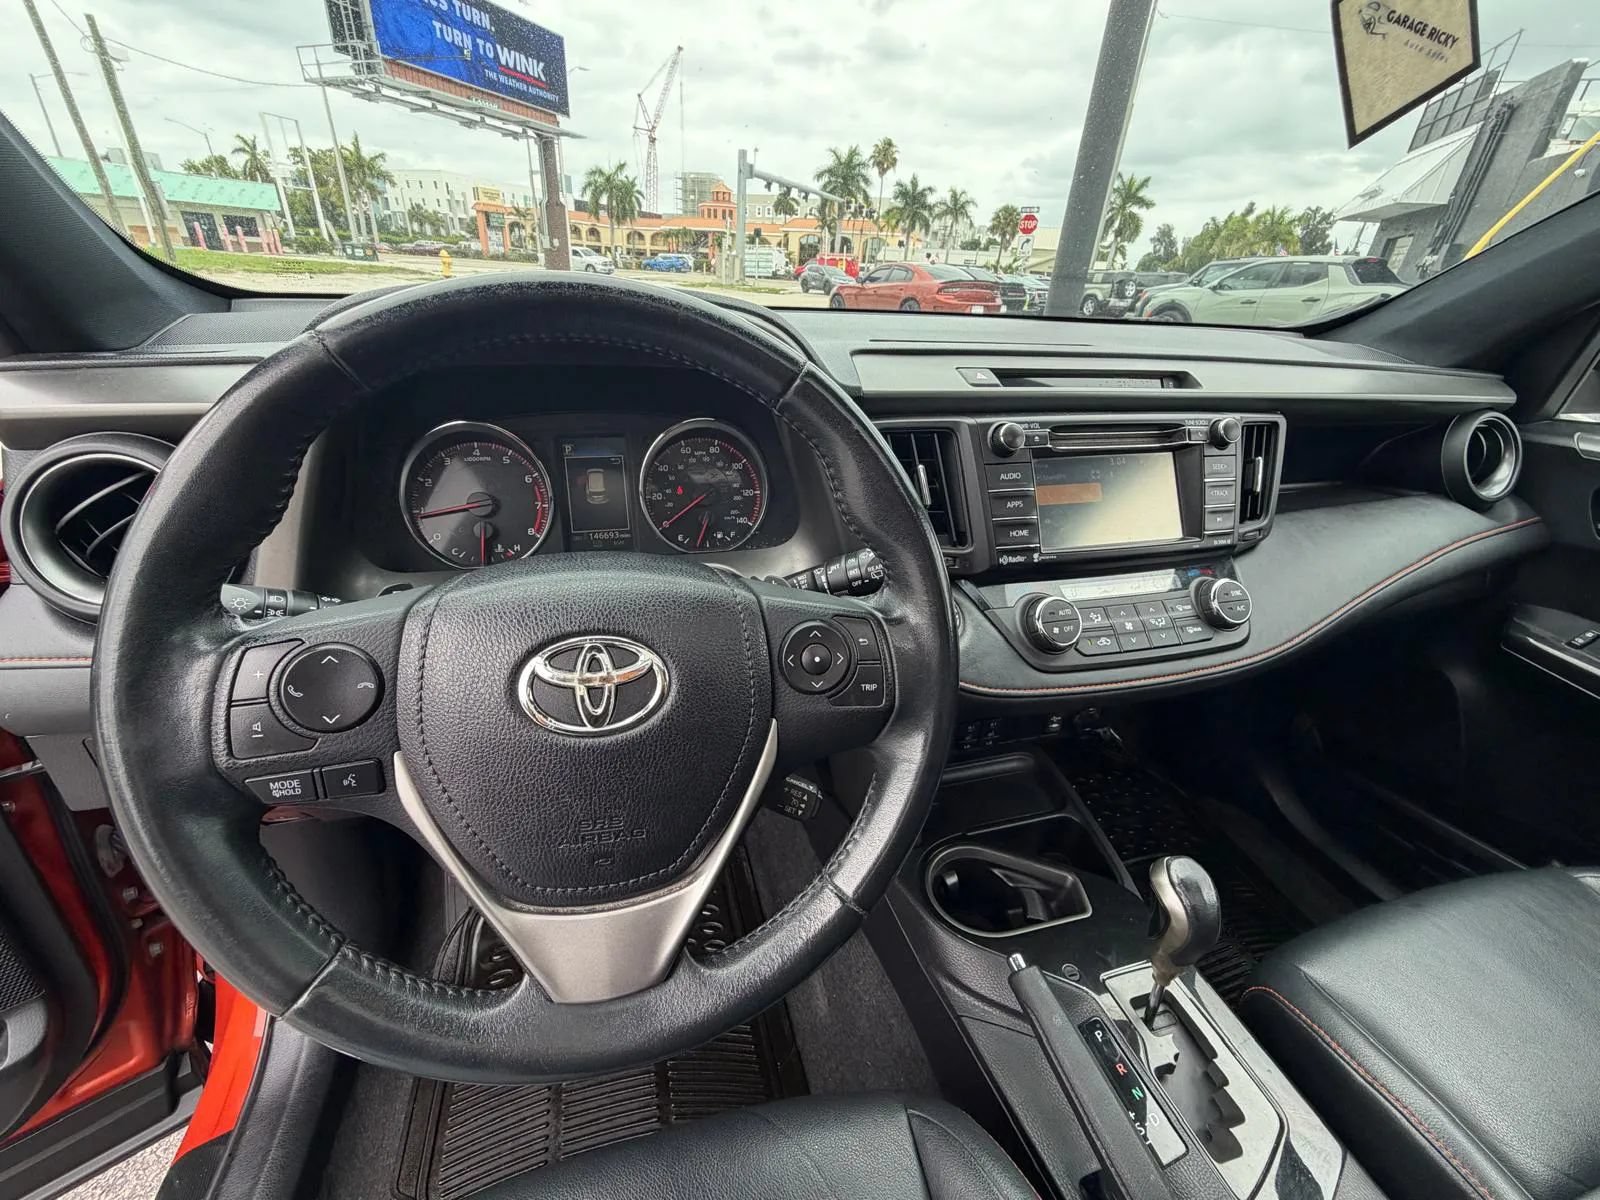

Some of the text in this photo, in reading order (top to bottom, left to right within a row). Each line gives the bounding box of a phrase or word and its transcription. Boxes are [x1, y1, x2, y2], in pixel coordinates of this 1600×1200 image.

[452, 0, 496, 32] TURN.
[1387, 9, 1460, 49] GARAGE RICKY
[432, 20, 546, 82] TURN TO WINK
[484, 69, 559, 103] THE WEATHER AUTHORITY
[1020, 219, 1038, 230] STOP
[472, 448, 480, 456] 4
[680, 446, 692, 454] 60
[709, 446, 720, 454] 80
[444, 457, 451, 465] 3
[502, 456, 510, 464] 5
[524, 474, 532, 483] 6
[1000, 472, 1022, 481] AUDIO
[424, 478, 433, 487] 2
[652, 492, 663, 500] 20
[742, 488, 754, 497] 120
[534, 501, 542, 510] 7
[1006, 500, 1024, 509] APPS
[527, 527, 535, 536] 8
[589, 531, 619, 541] 146693
[1009, 529, 1030, 537] HOME
[433, 532, 441, 541] 0
[677, 534, 685, 542] E
[451, 547, 459, 556] C
[513, 543, 521, 552] H
[867, 563, 883, 572] REAR
[851, 579, 862, 587] OFF
[1058, 608, 1072, 616] AUTO
[1063, 625, 1074, 633] OFF
[860, 683, 878, 691] TRIP
[269, 779, 301, 790] MODE
[785, 776, 809, 790] CANCEL
[280, 788, 302, 797] HOLD
[580, 816, 624, 832] SRS
[558, 828, 647, 849] AIRBAG
[1094, 1030, 1103, 1042] P
[1115, 1063, 1128, 1076] R
[1131, 1086, 1144, 1101] N
[1149, 1112, 1160, 1127] D
[1135, 1122, 1146, 1136] S
